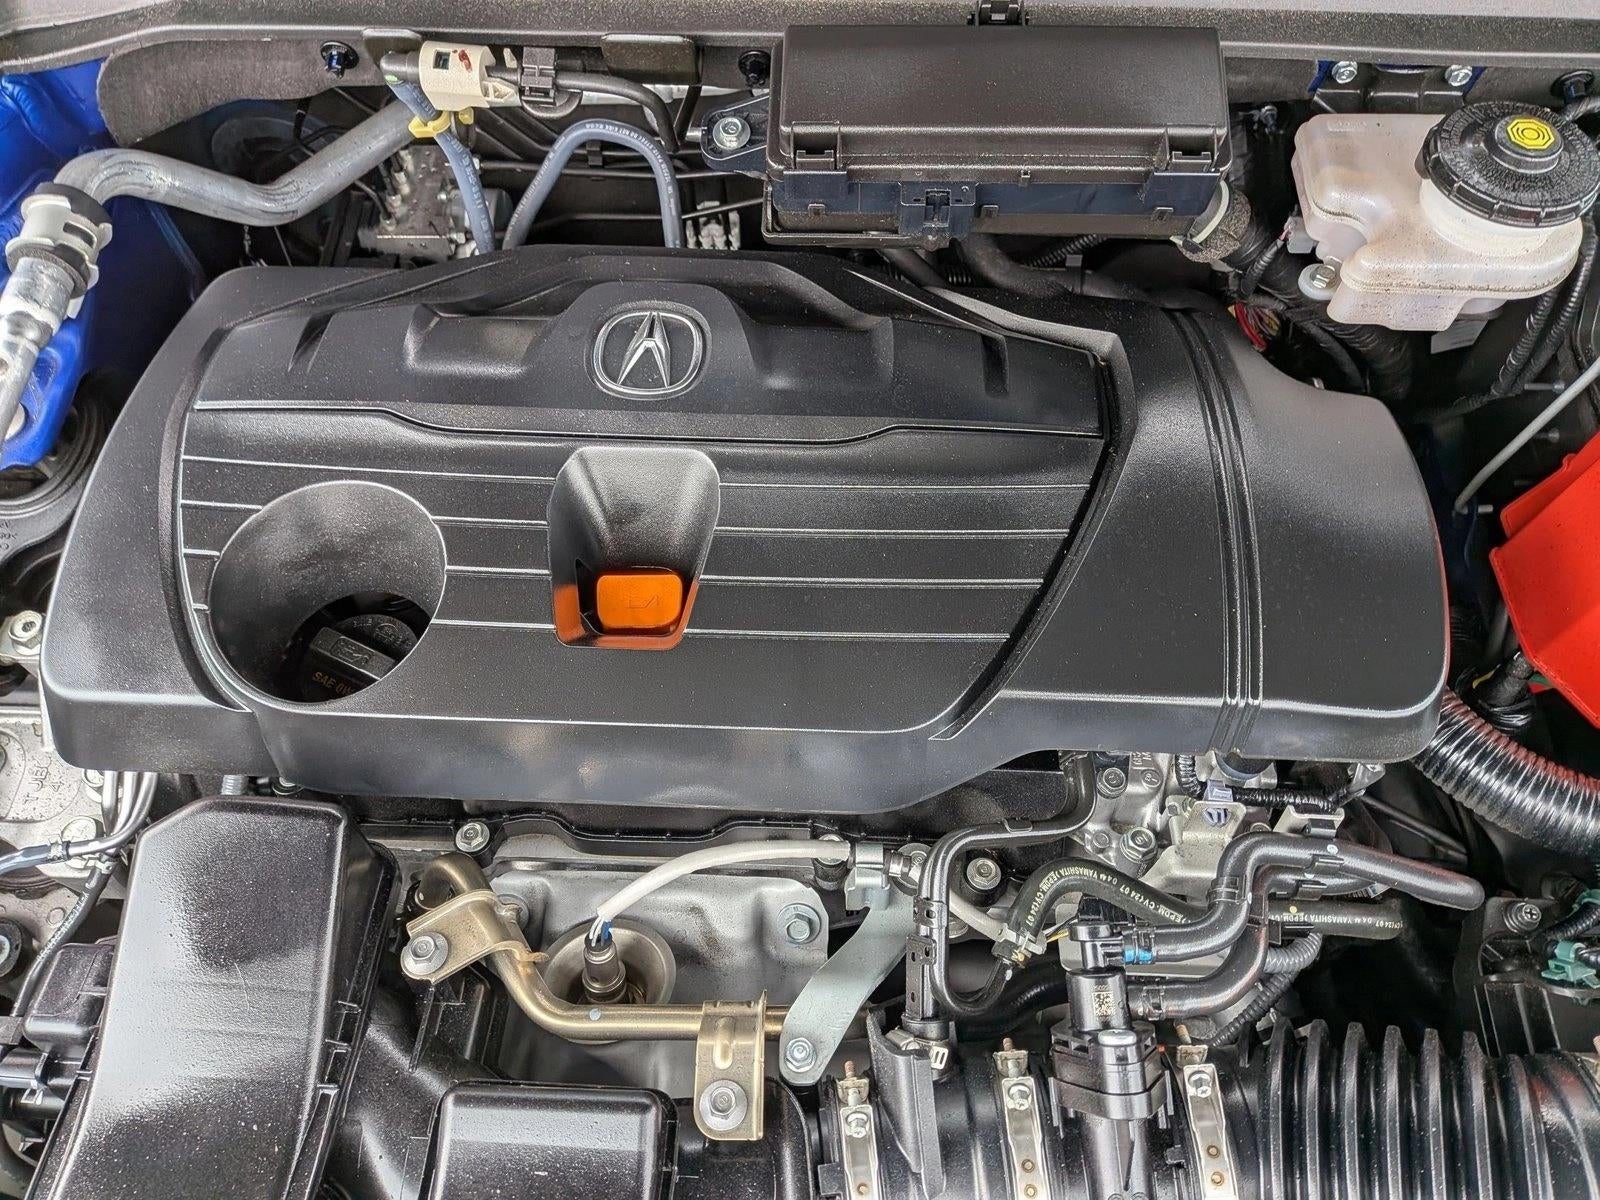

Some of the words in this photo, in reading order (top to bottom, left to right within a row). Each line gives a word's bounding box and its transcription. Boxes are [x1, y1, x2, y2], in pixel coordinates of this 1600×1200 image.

[312, 671, 336, 689] SAE
[1059, 867, 1098, 880] YAMASHITA
[1310, 913, 1353, 924] YAMASHITA
